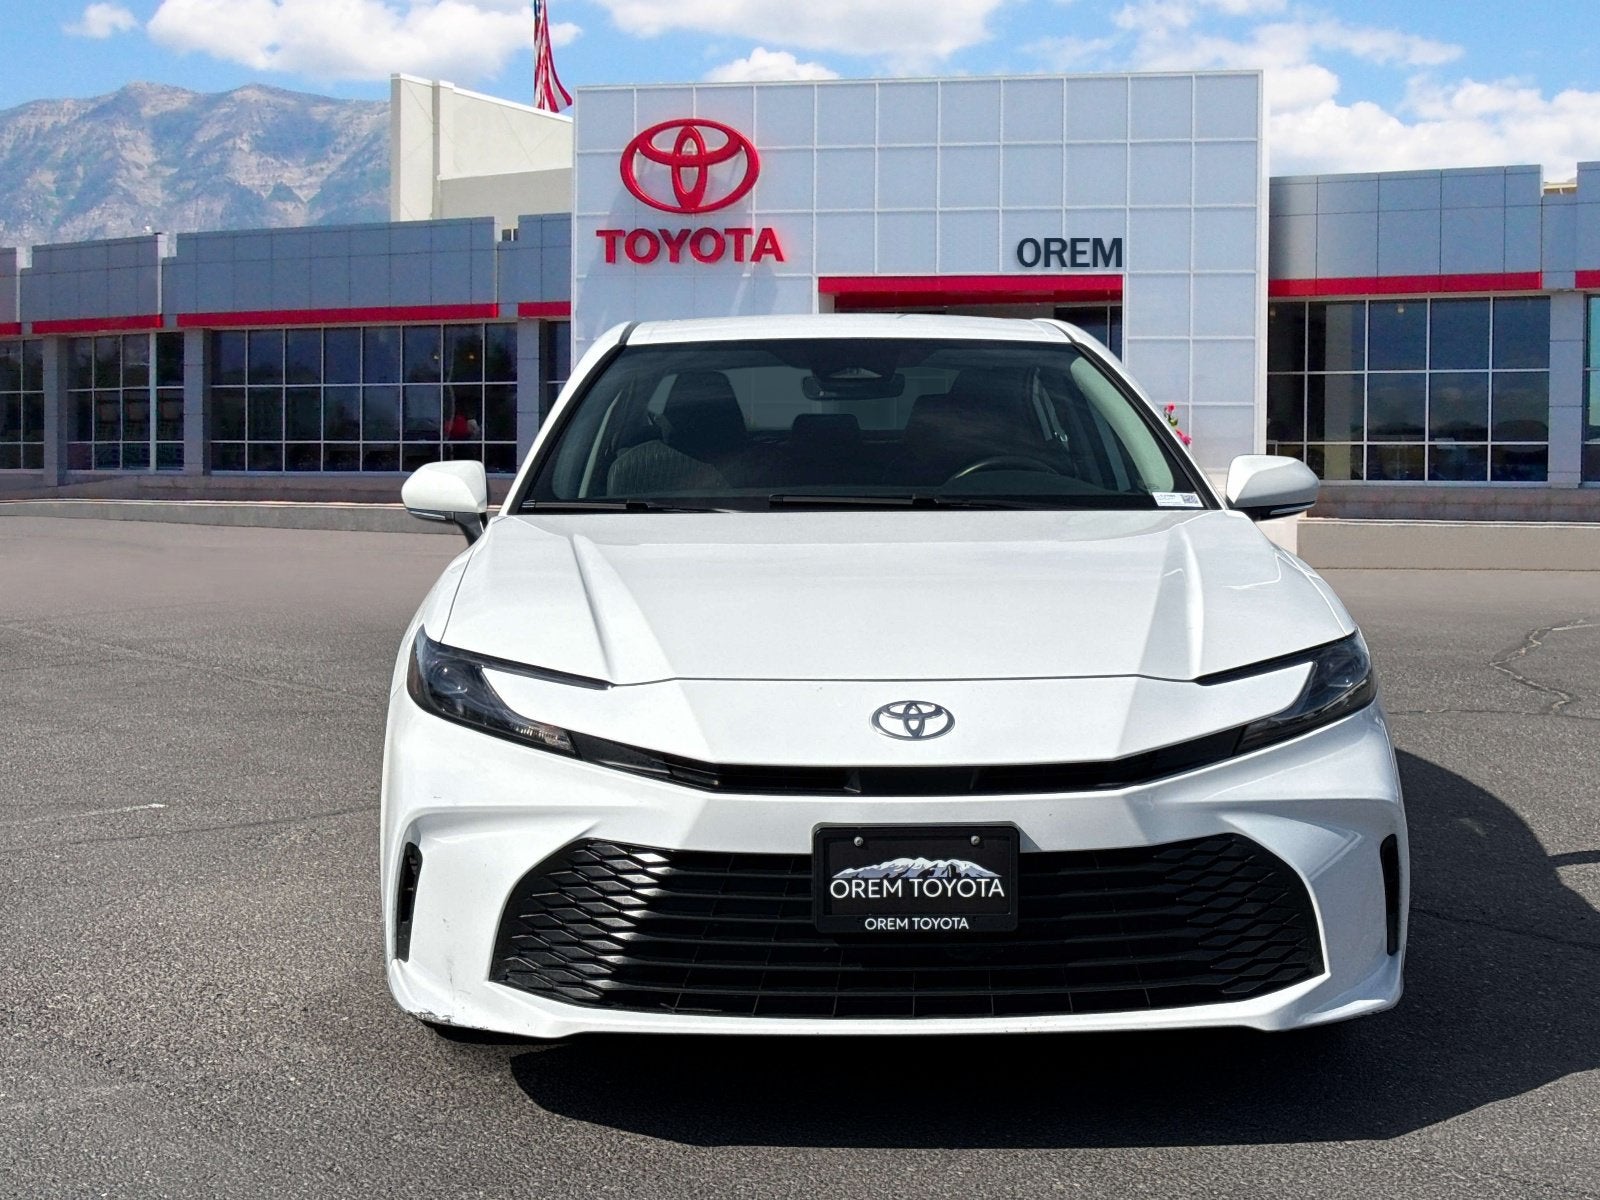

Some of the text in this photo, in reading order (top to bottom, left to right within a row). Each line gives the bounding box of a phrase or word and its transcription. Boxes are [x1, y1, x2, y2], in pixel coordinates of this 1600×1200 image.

[596, 227, 784, 264] TOYOTA
[1016, 237, 1123, 268] OREM
[830, 878, 1005, 898] OREM TOYOTA
[864, 917, 970, 930] OREM TOYOTA
